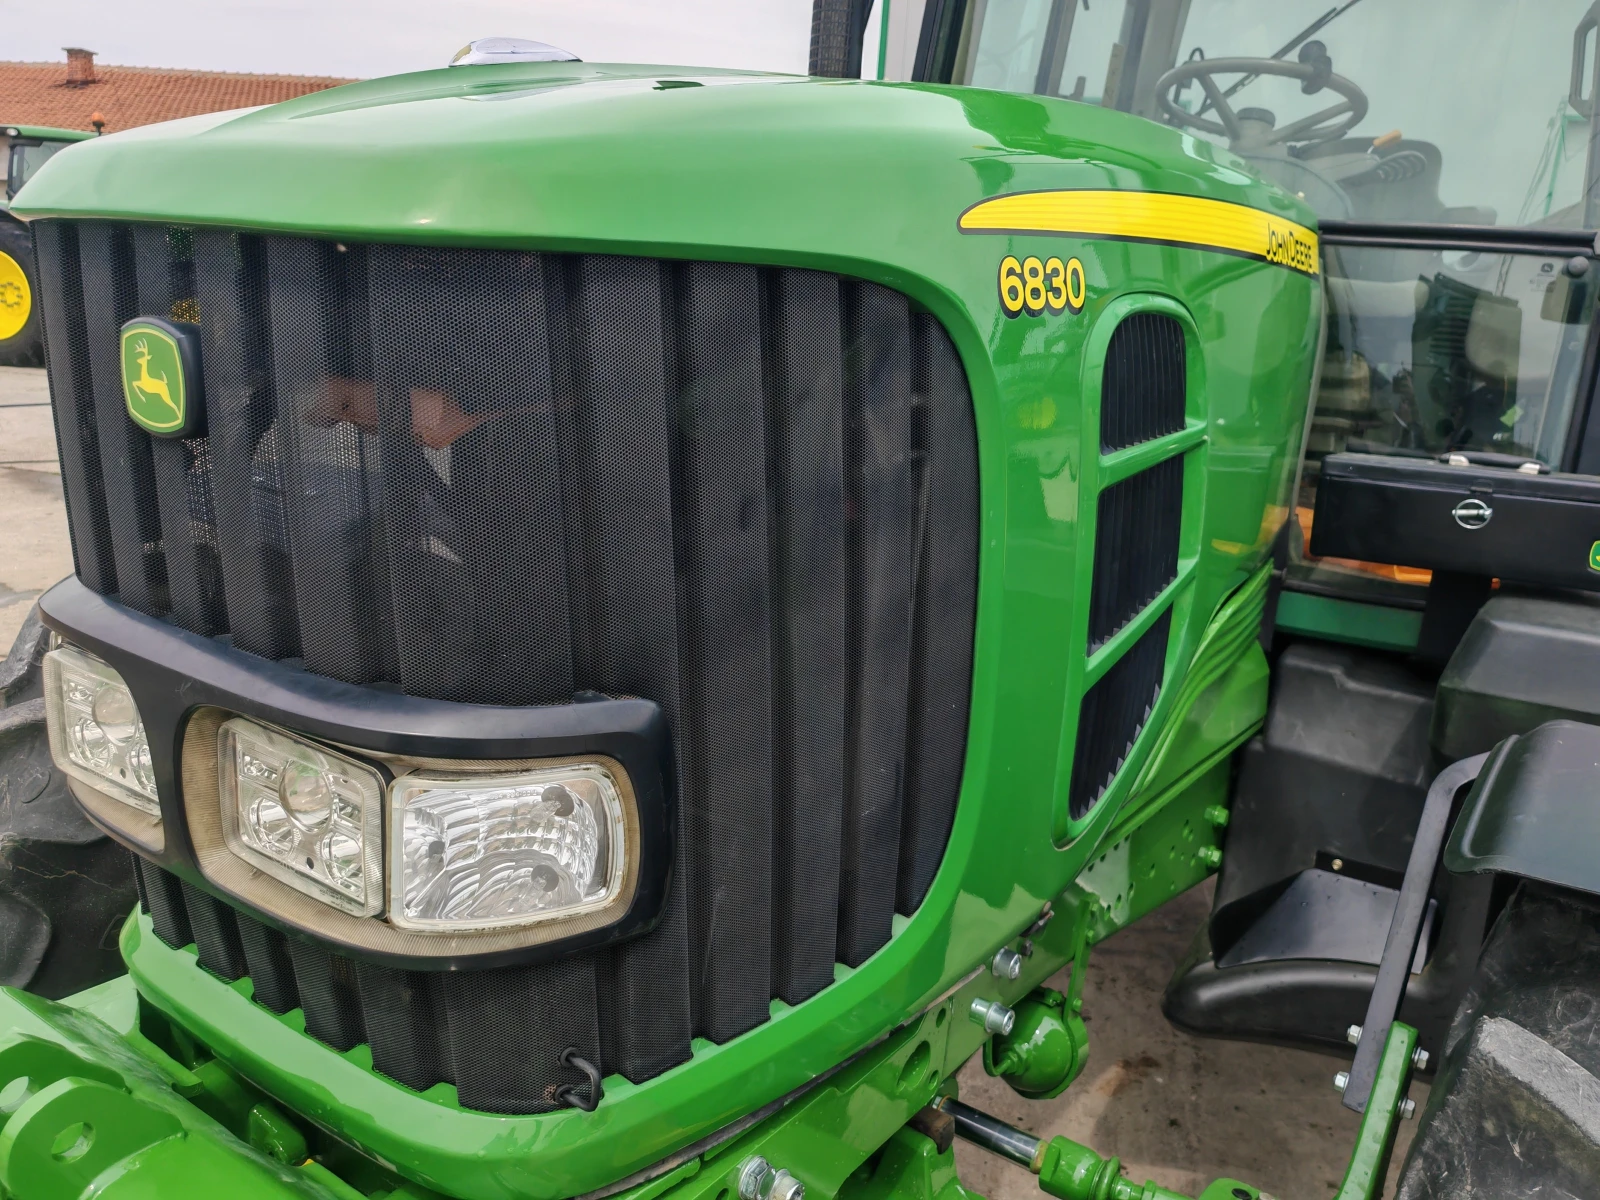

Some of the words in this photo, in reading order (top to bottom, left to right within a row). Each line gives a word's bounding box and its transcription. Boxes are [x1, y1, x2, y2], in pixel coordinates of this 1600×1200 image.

[1266, 222, 1289, 262] JOHN
[1289, 230, 1313, 270] DEERE
[999, 255, 1086, 316] 6830
